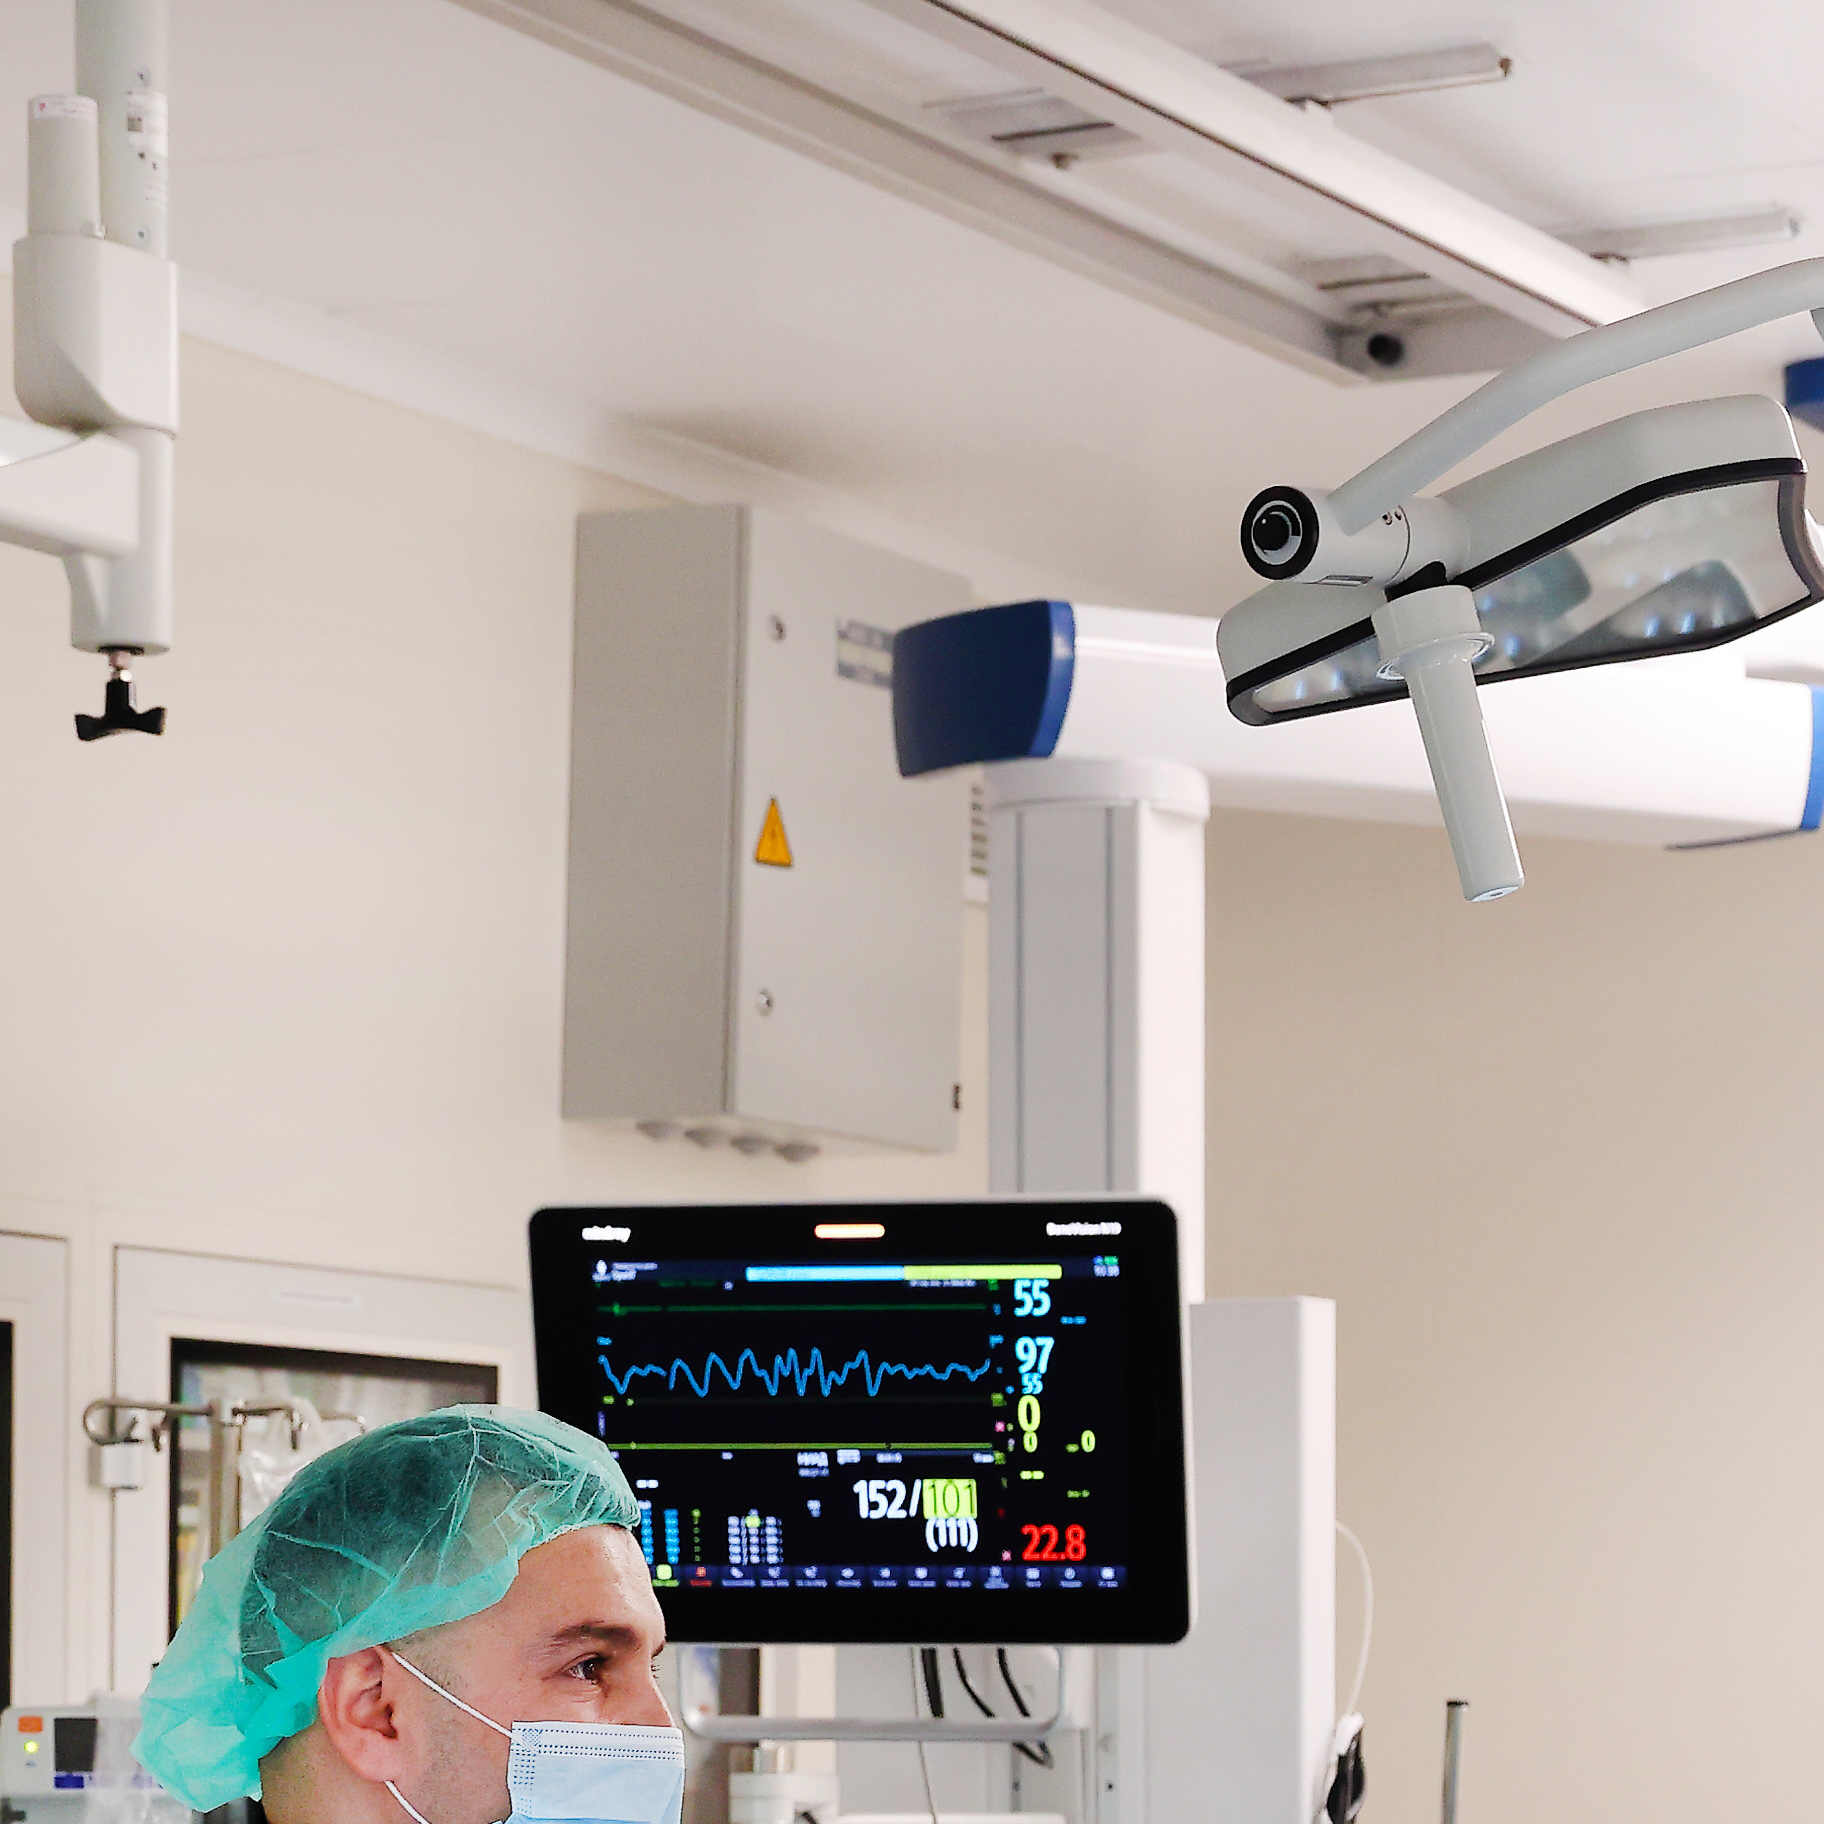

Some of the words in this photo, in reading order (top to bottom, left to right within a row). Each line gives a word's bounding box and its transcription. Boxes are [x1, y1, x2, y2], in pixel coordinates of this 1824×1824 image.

[1013, 1278, 1051, 1317] 55
[1014, 1336, 1055, 1374] 97
[1021, 1372, 1044, 1395] 55
[1017, 1395, 1041, 1432] 0
[1022, 1431, 1038, 1453] 0
[1080, 1429, 1096, 1453] 0
[1020, 1523, 1087, 1561] 22.8
